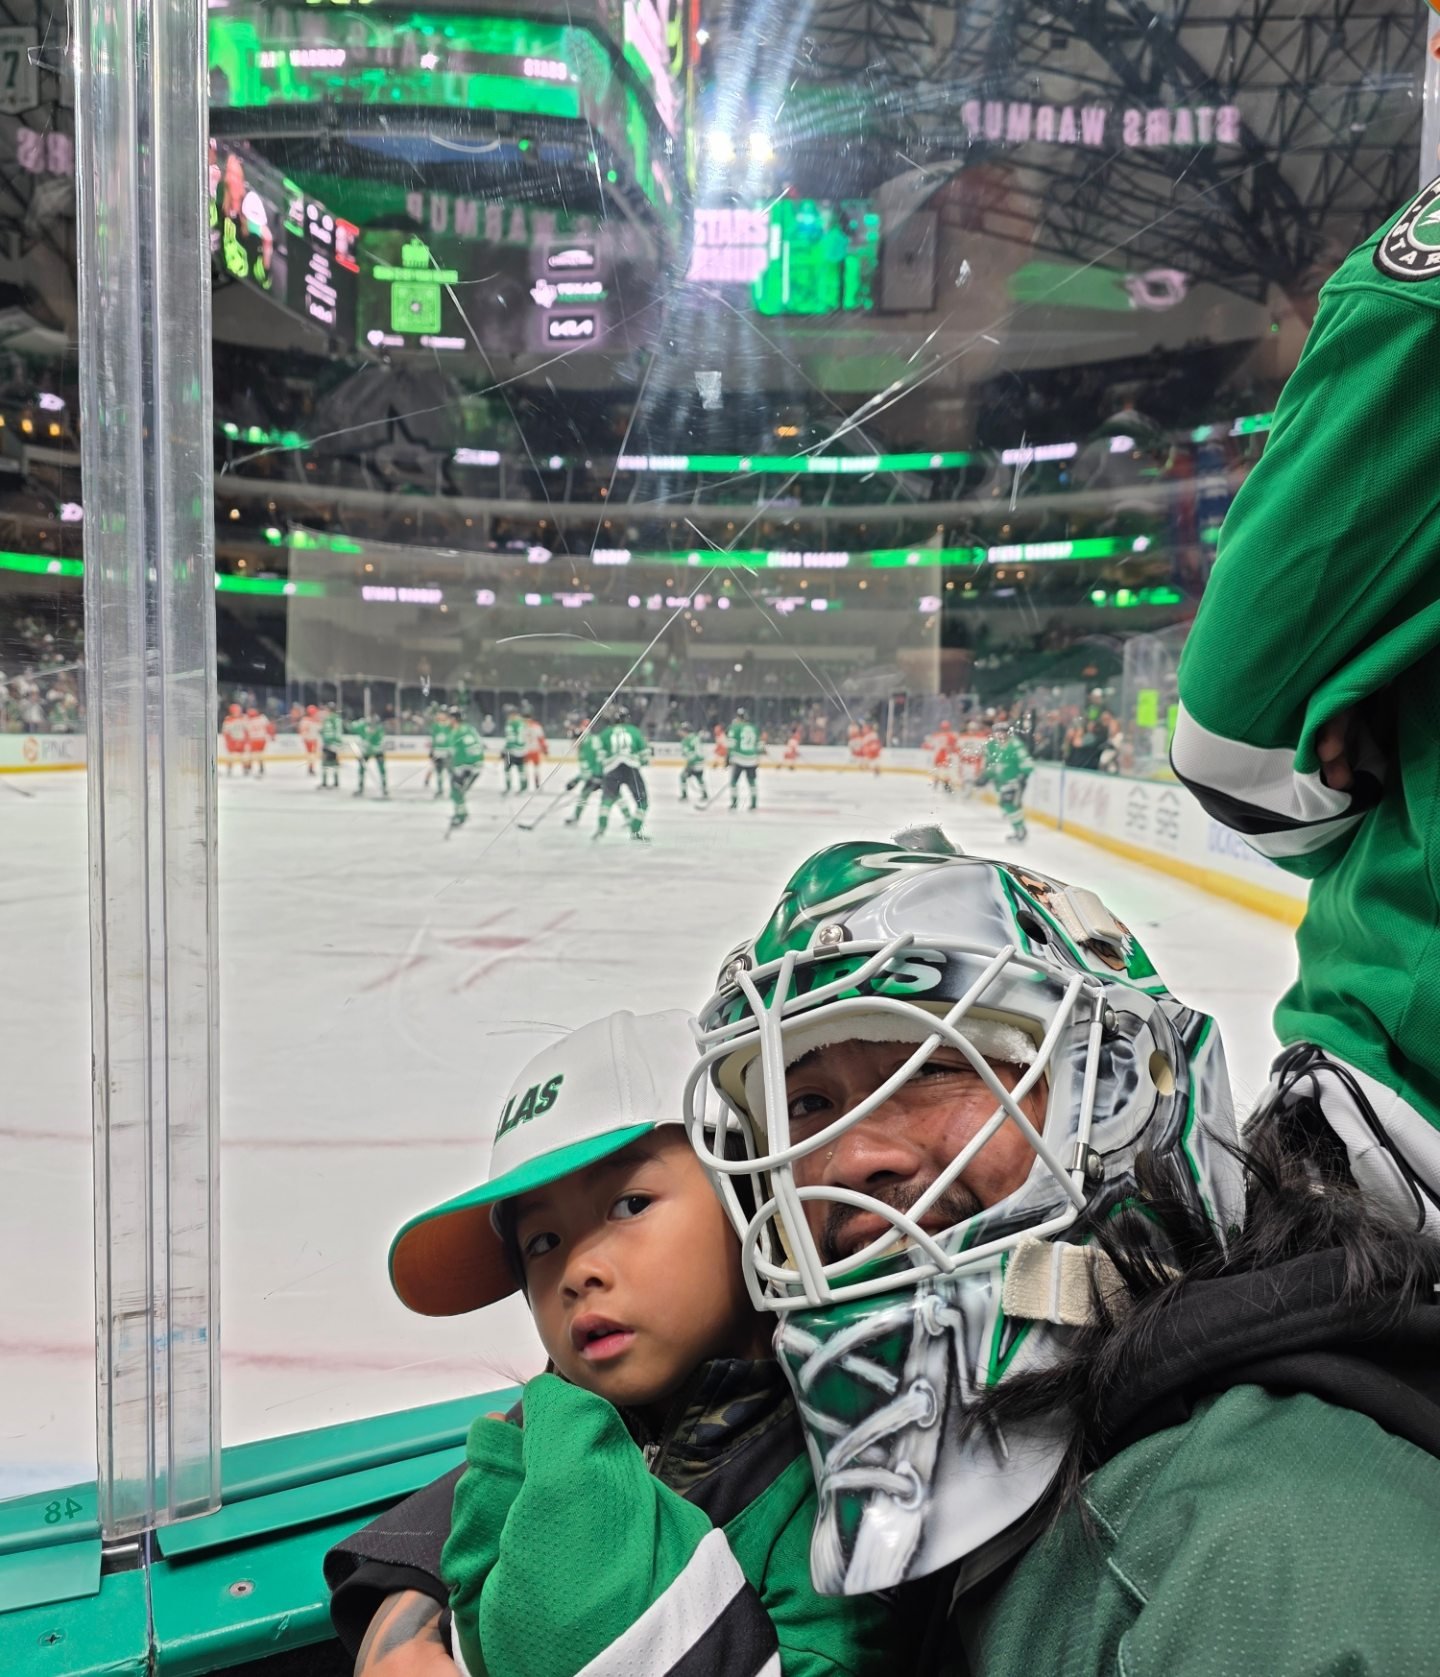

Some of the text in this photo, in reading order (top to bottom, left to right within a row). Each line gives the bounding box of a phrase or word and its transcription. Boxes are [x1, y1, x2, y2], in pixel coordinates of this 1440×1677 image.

[3, 51, 20, 88] 7
[42, 739, 75, 761] PNC
[494, 1073, 564, 1146] LAS
